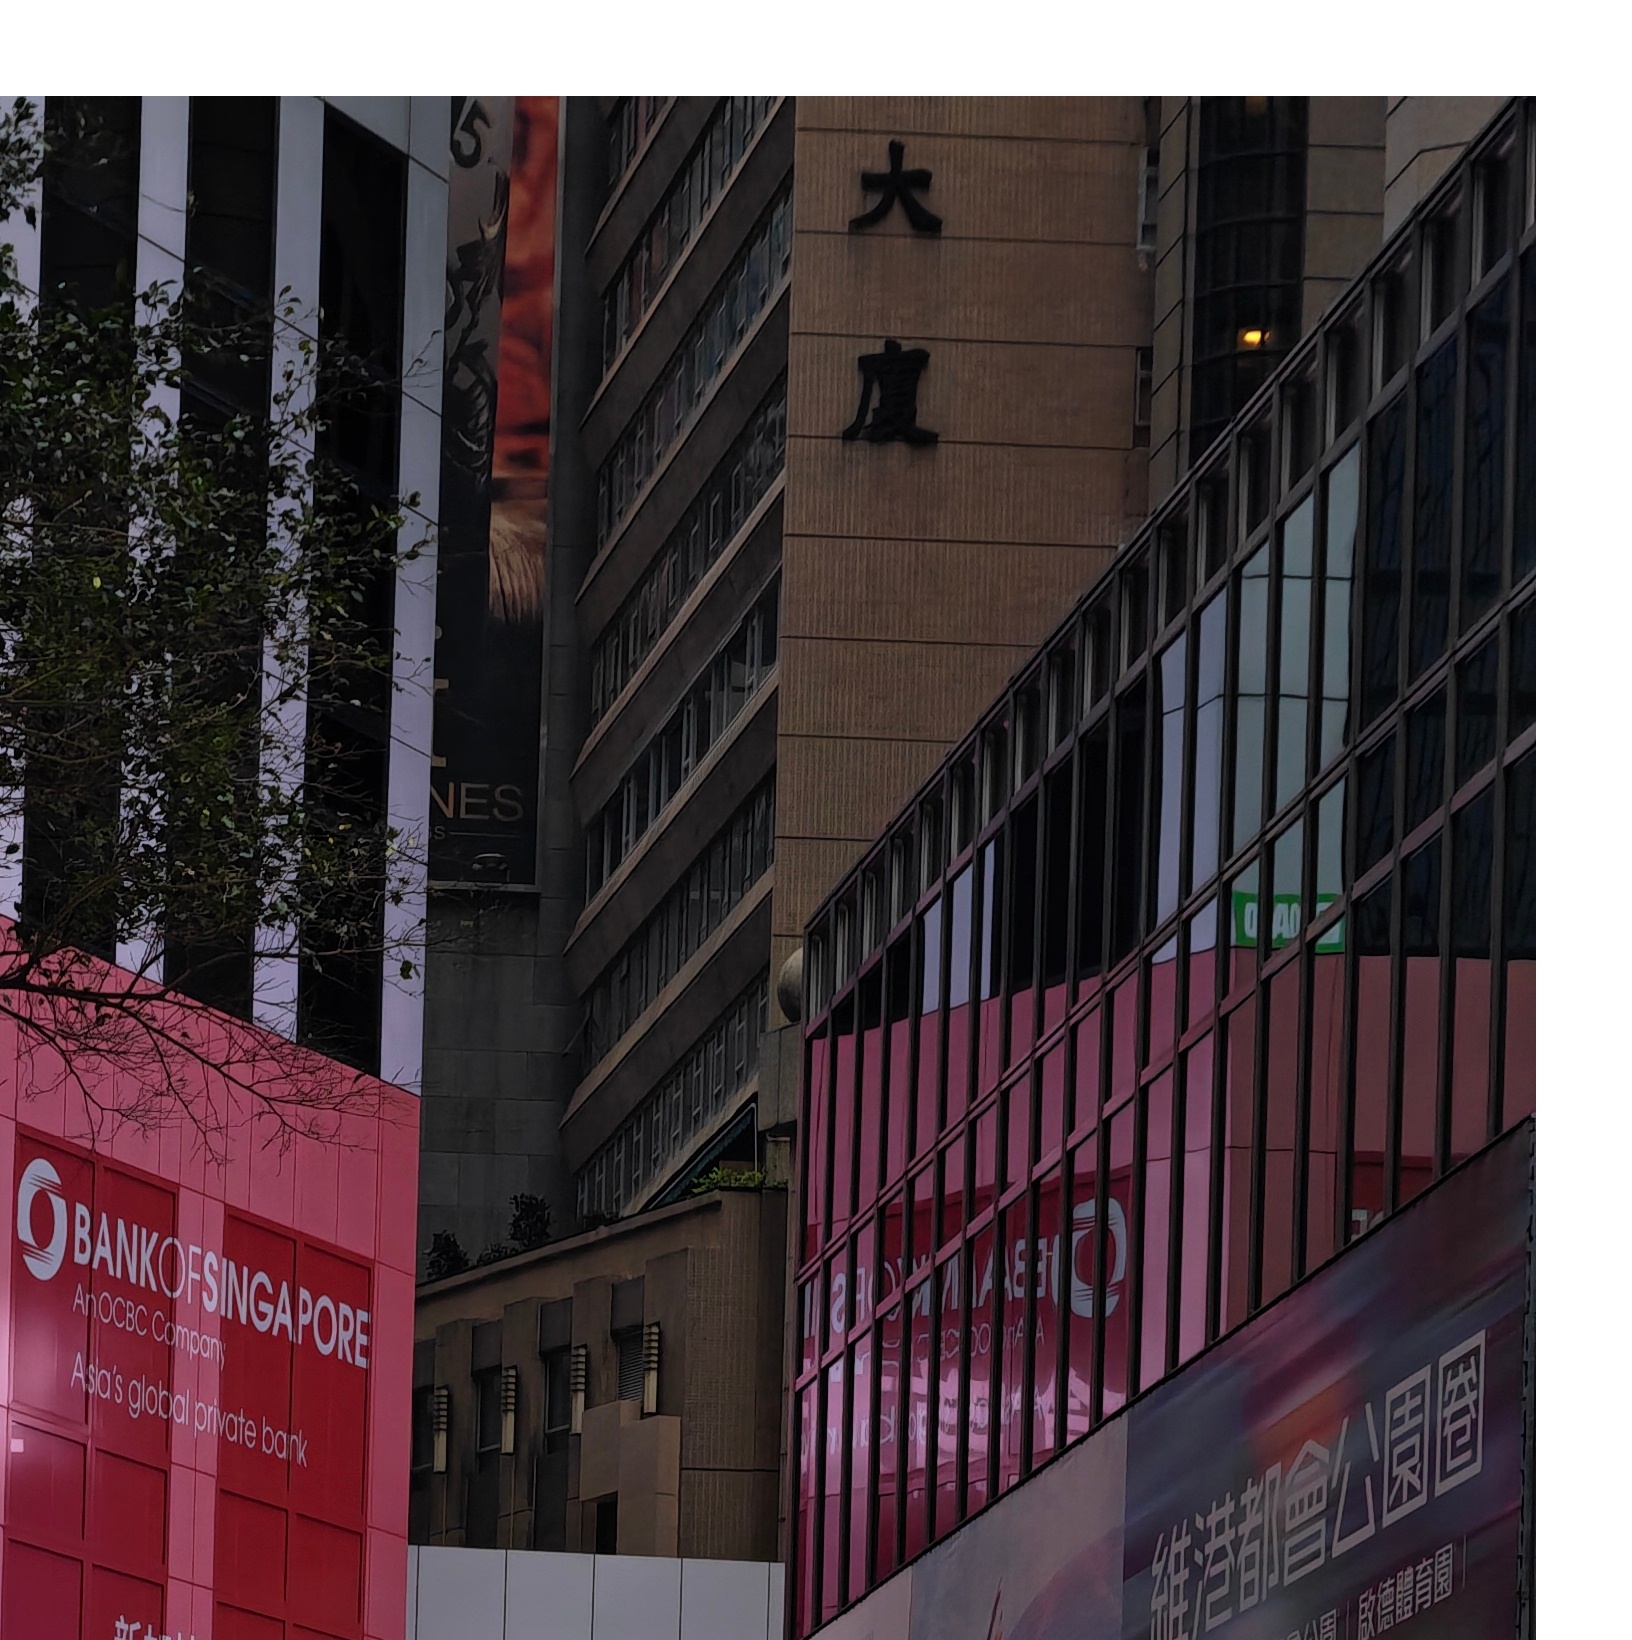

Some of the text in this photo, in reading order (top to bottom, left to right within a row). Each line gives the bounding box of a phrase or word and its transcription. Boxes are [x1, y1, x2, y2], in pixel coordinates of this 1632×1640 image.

[842, 139, 942, 442] 大廈
[73, 1282, 226, 1372] An OCBC Company
[74, 1201, 159, 1293] BANK
[202, 1250, 371, 1370] SINGAPORE
[71, 1351, 308, 1469] Asia's global private bank
